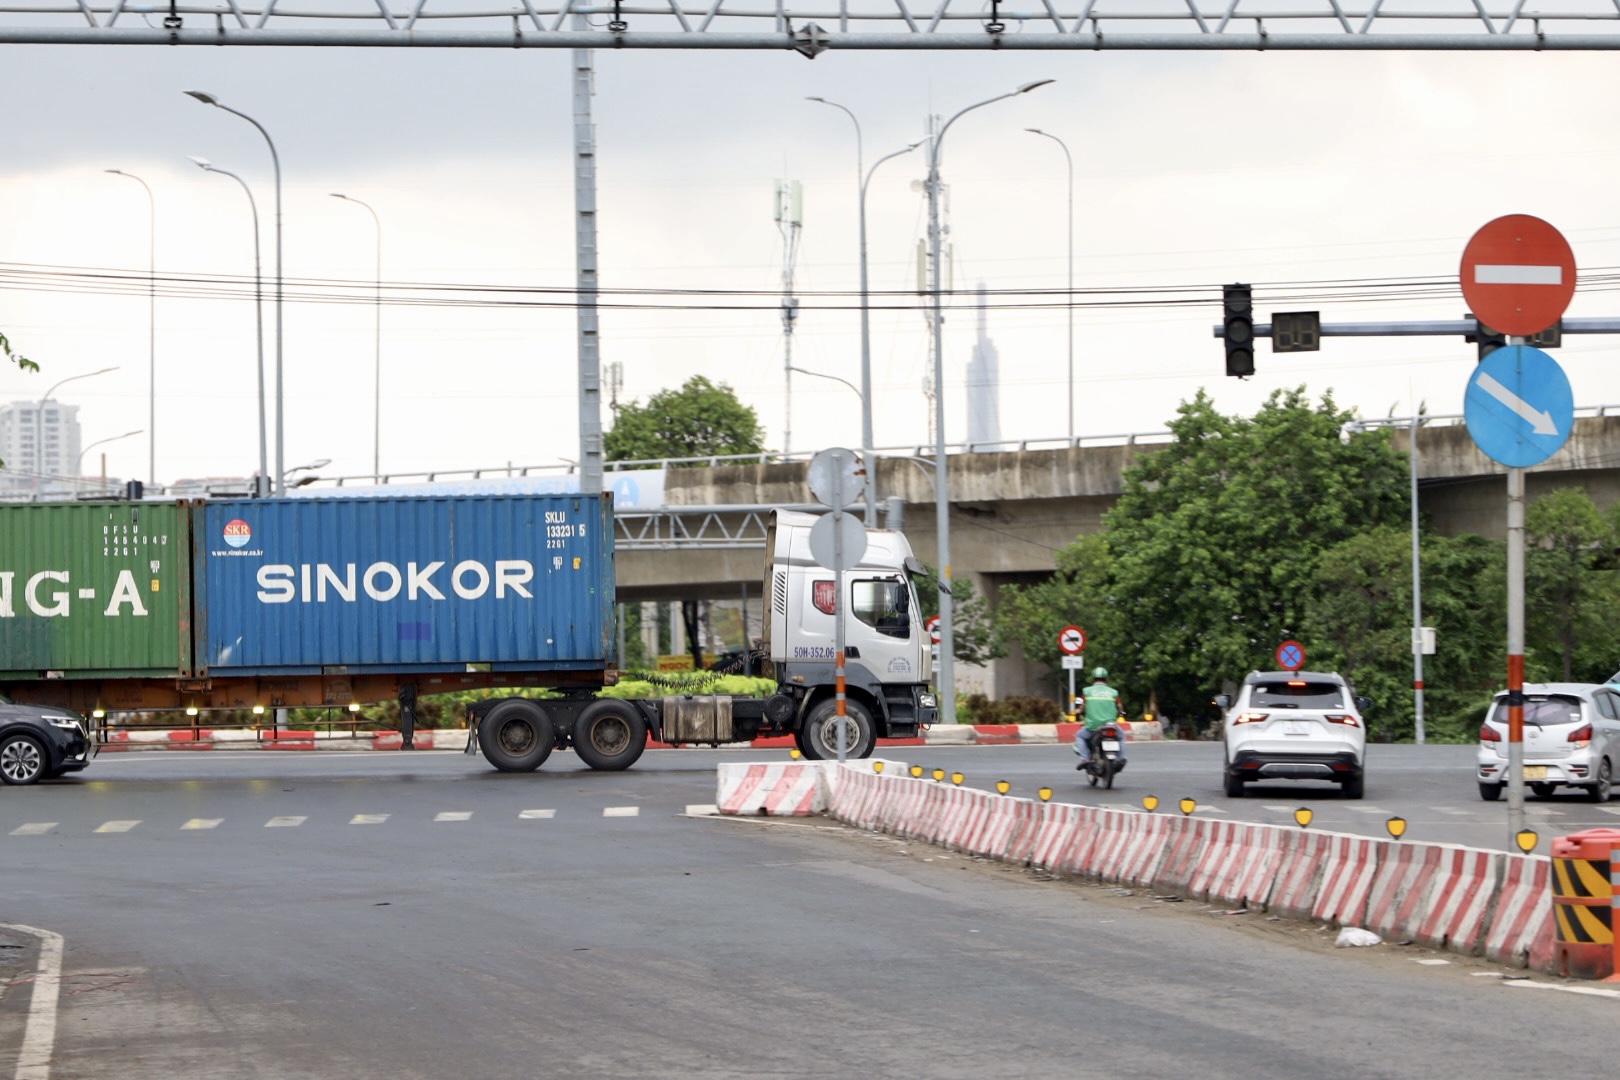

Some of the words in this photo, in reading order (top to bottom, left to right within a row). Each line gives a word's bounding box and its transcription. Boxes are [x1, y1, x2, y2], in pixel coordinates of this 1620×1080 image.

[545, 511, 566, 524] SKLU
[225, 525, 249, 535] SKR
[546, 524, 575, 538] 133231
[257, 559, 534, 604] SINOKOR
[794, 646, 835, 659] 50H-352.06
